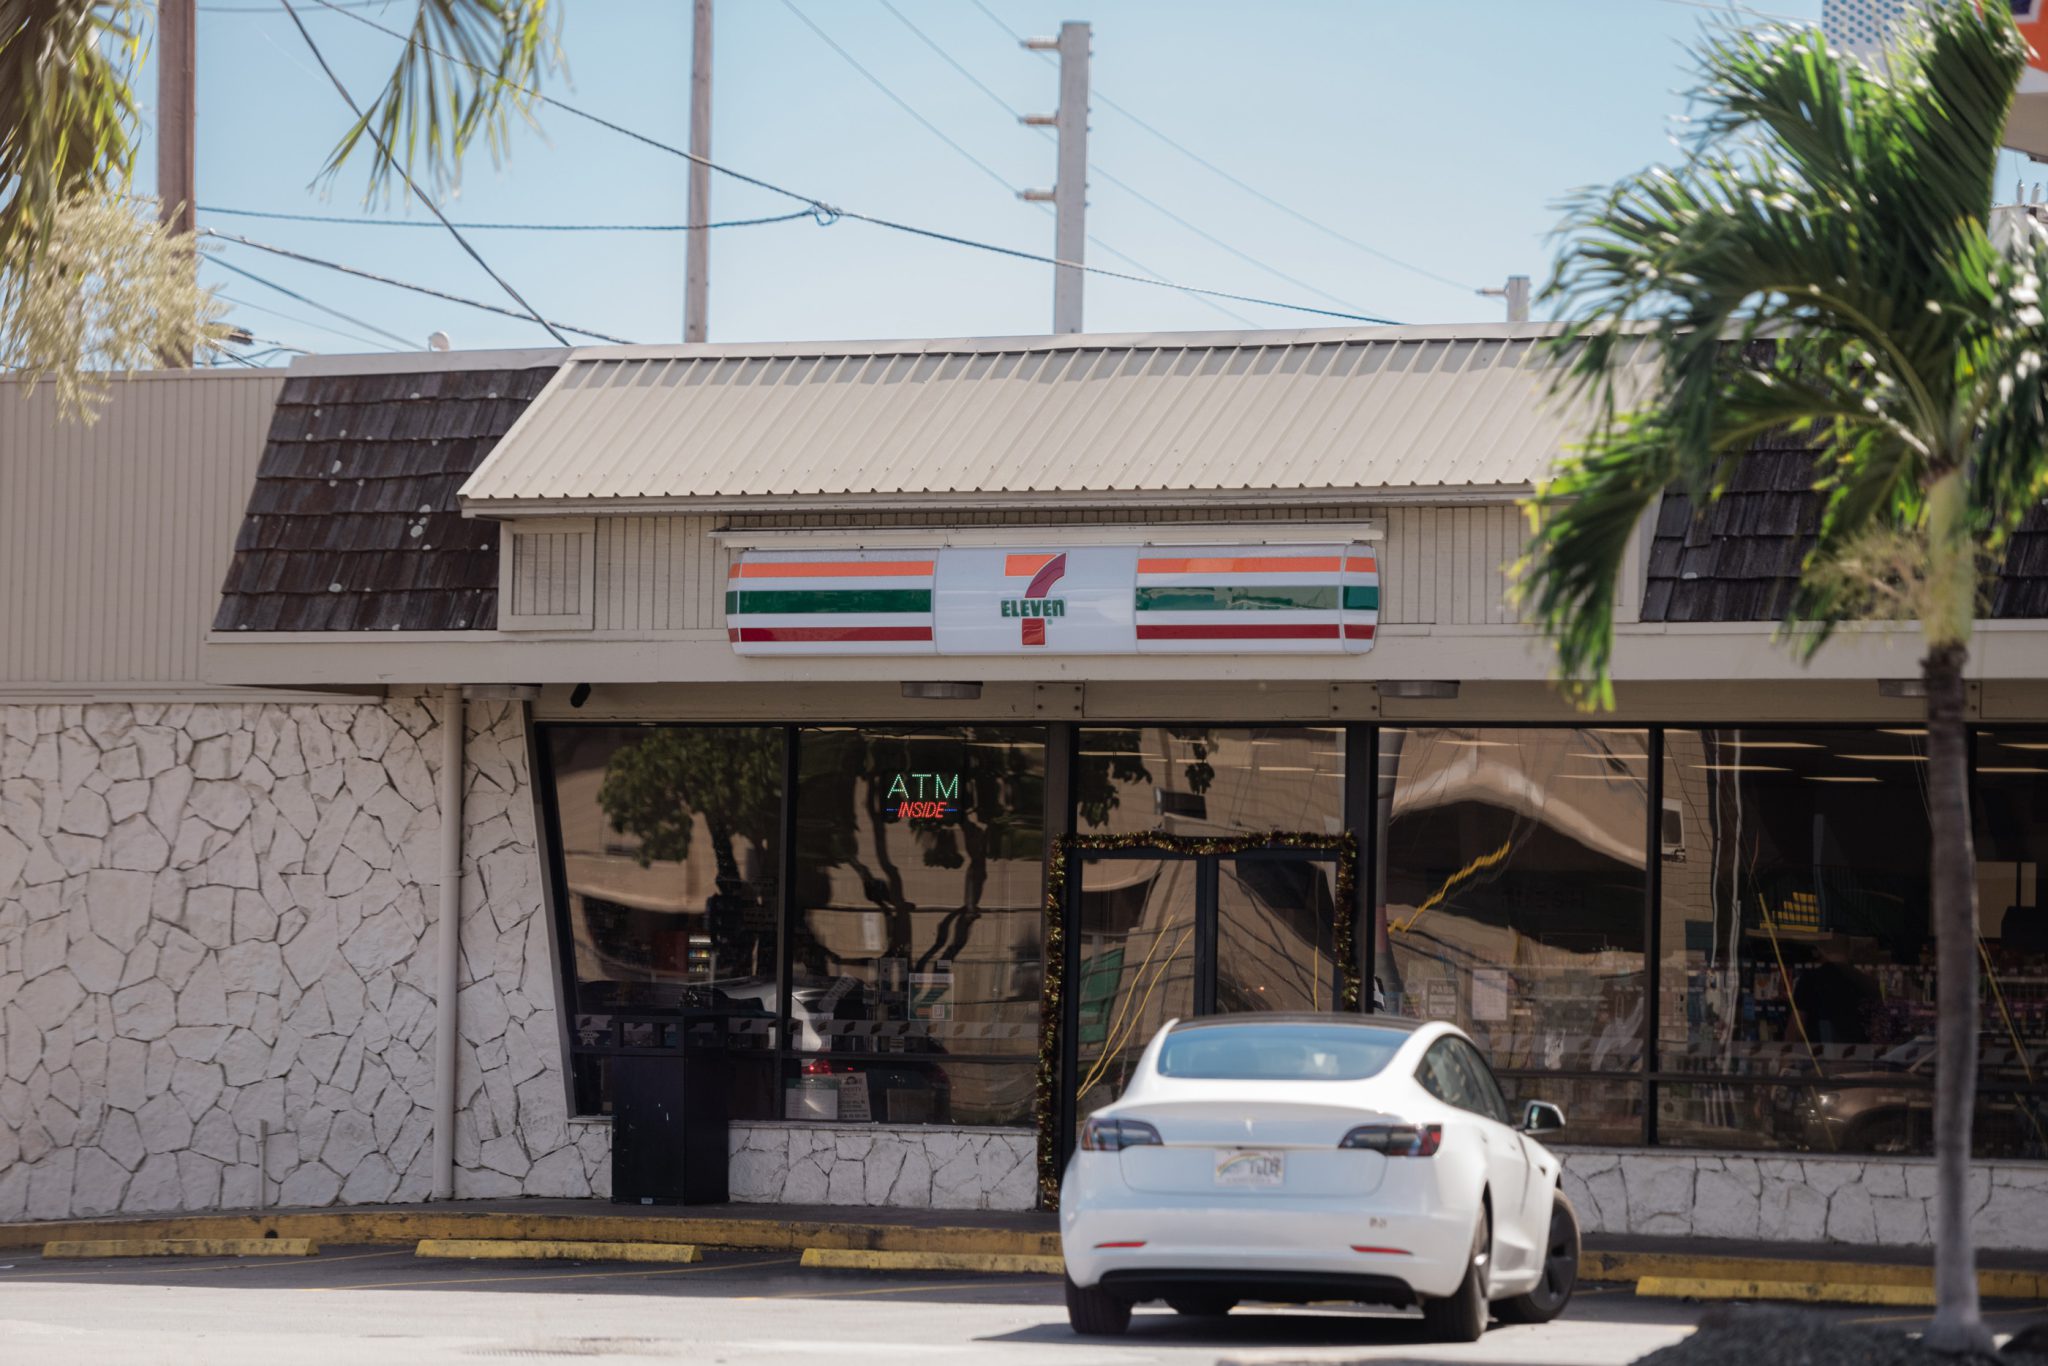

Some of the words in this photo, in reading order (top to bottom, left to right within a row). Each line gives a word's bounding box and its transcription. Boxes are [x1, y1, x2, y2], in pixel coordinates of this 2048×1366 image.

[1004, 552, 1067, 646] 7
[887, 773, 958, 799] ATM
[898, 801, 948, 818] INSIDE
